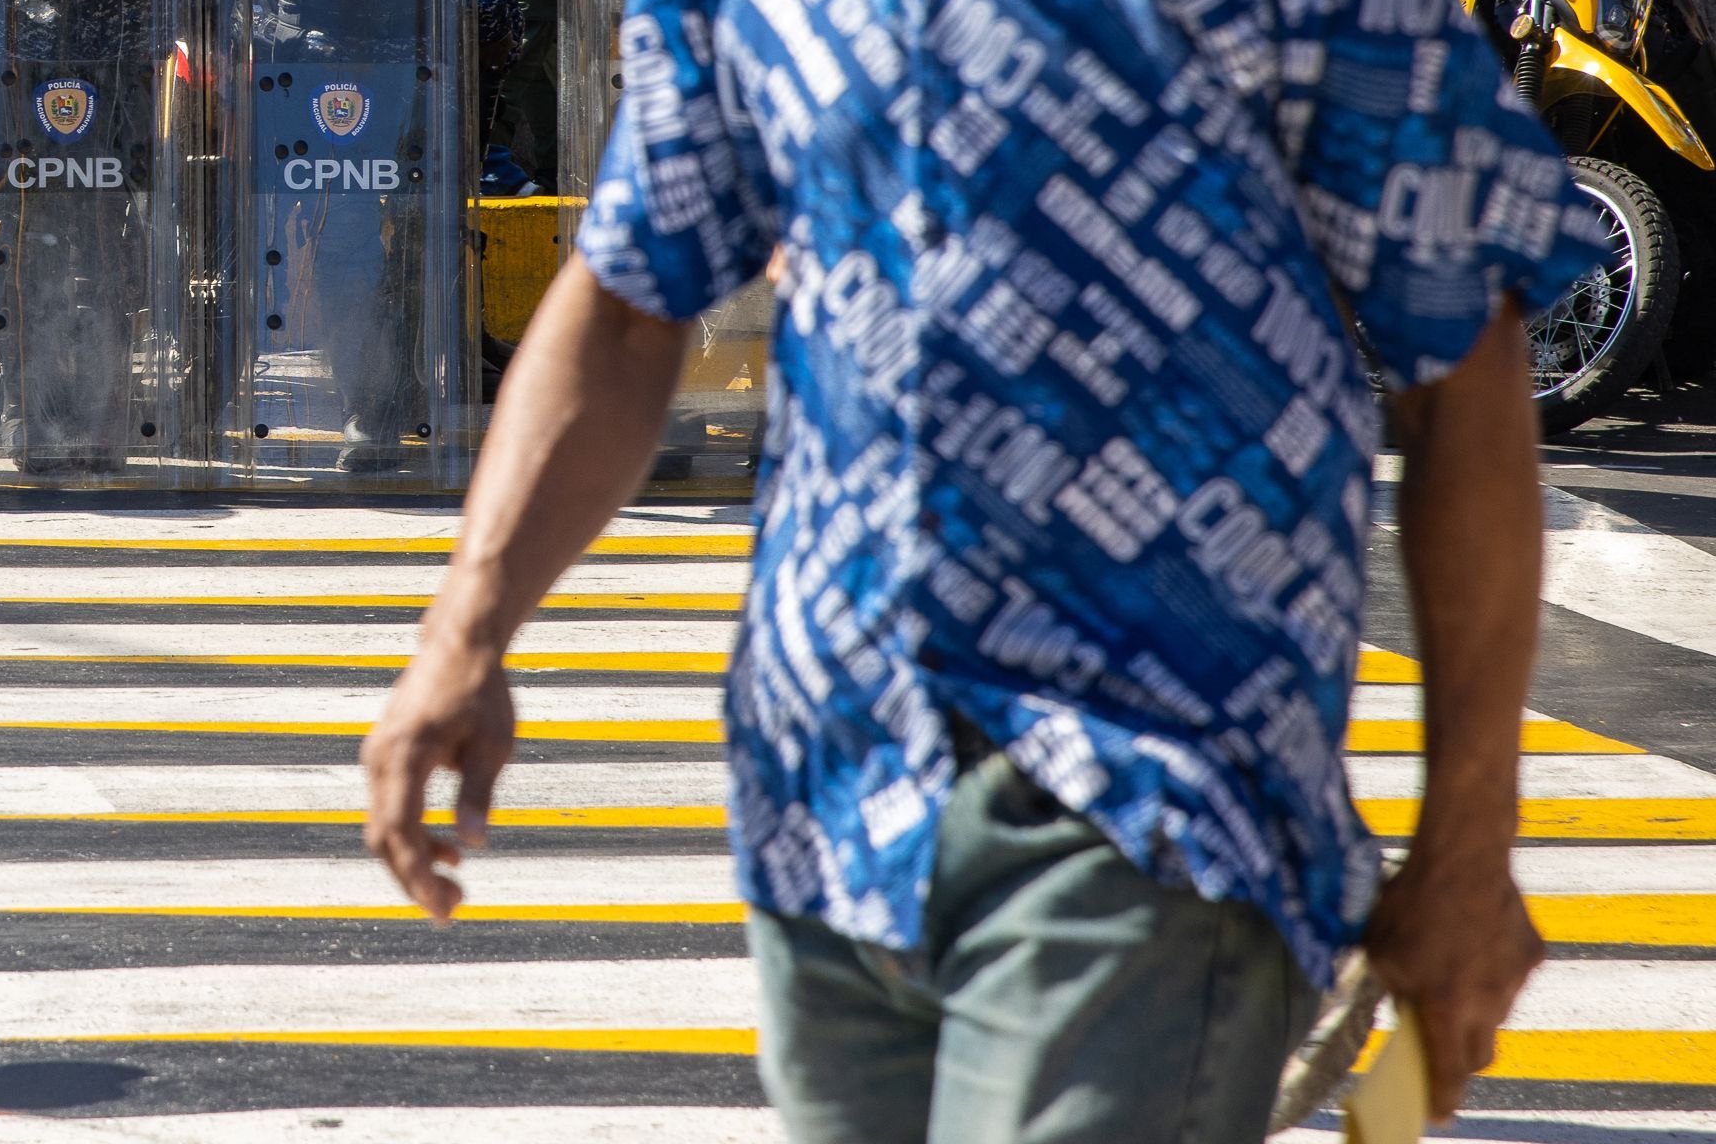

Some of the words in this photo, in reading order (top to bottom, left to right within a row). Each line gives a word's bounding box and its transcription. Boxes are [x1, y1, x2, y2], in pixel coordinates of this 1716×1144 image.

[47, 81, 81, 90] POLICÍA
[324, 83, 358, 92] POLICÍA
[36, 97, 52, 133] NACIONAL
[313, 98, 328, 134] NACIONAL
[7, 157, 124, 189] CPNB
[283, 158, 400, 190] CPNB
